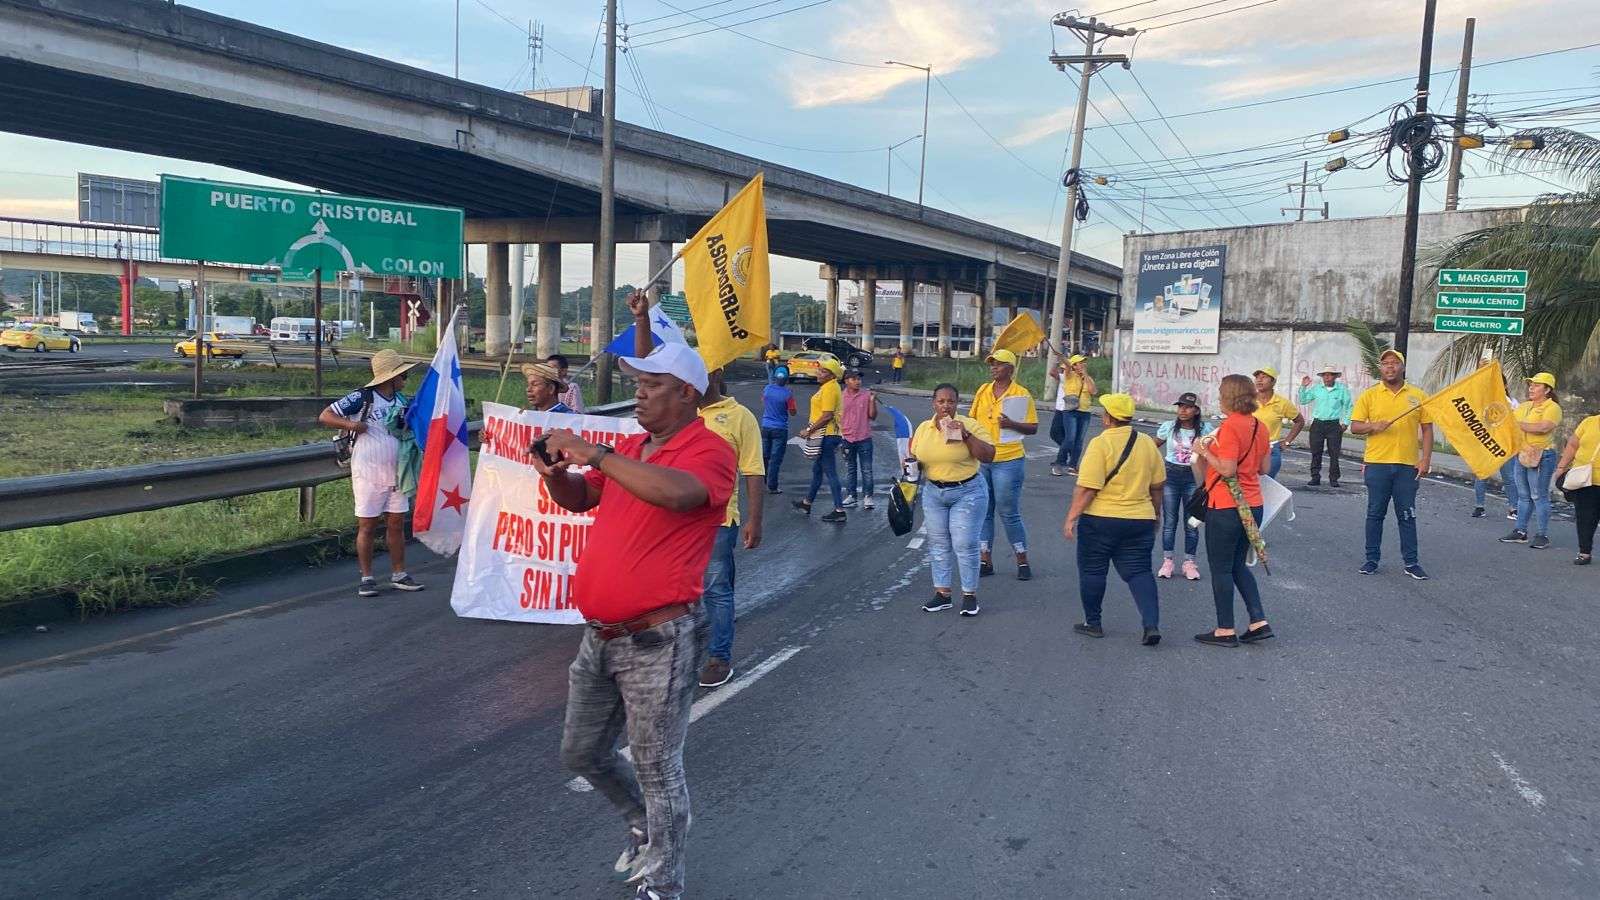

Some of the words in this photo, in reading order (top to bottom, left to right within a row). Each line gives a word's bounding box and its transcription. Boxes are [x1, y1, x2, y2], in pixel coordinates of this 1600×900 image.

[211, 191, 295, 214] PUERTO
[308, 201, 418, 227] CRISTOBAL
[1160, 252, 1176, 260] Zona
[1177, 251, 1192, 259] Libre
[1201, 249, 1220, 257] Colón
[381, 257, 445, 275] COLON
[1172, 261, 1179, 269] la
[1457, 273, 1520, 283] MARGARITA
[1453, 296, 1485, 305] PANAMÁ
[1486, 298, 1519, 306] CENTRO
[1441, 319, 1468, 328] COLÓN
[1470, 321, 1502, 329] CENTRO
[1121, 360, 1140, 379] NO
[1452, 396, 1507, 458] ASOMOGRERP
[493, 512, 534, 557] PERO
[538, 521, 555, 560] SI
[520, 568, 552, 609] SIN
